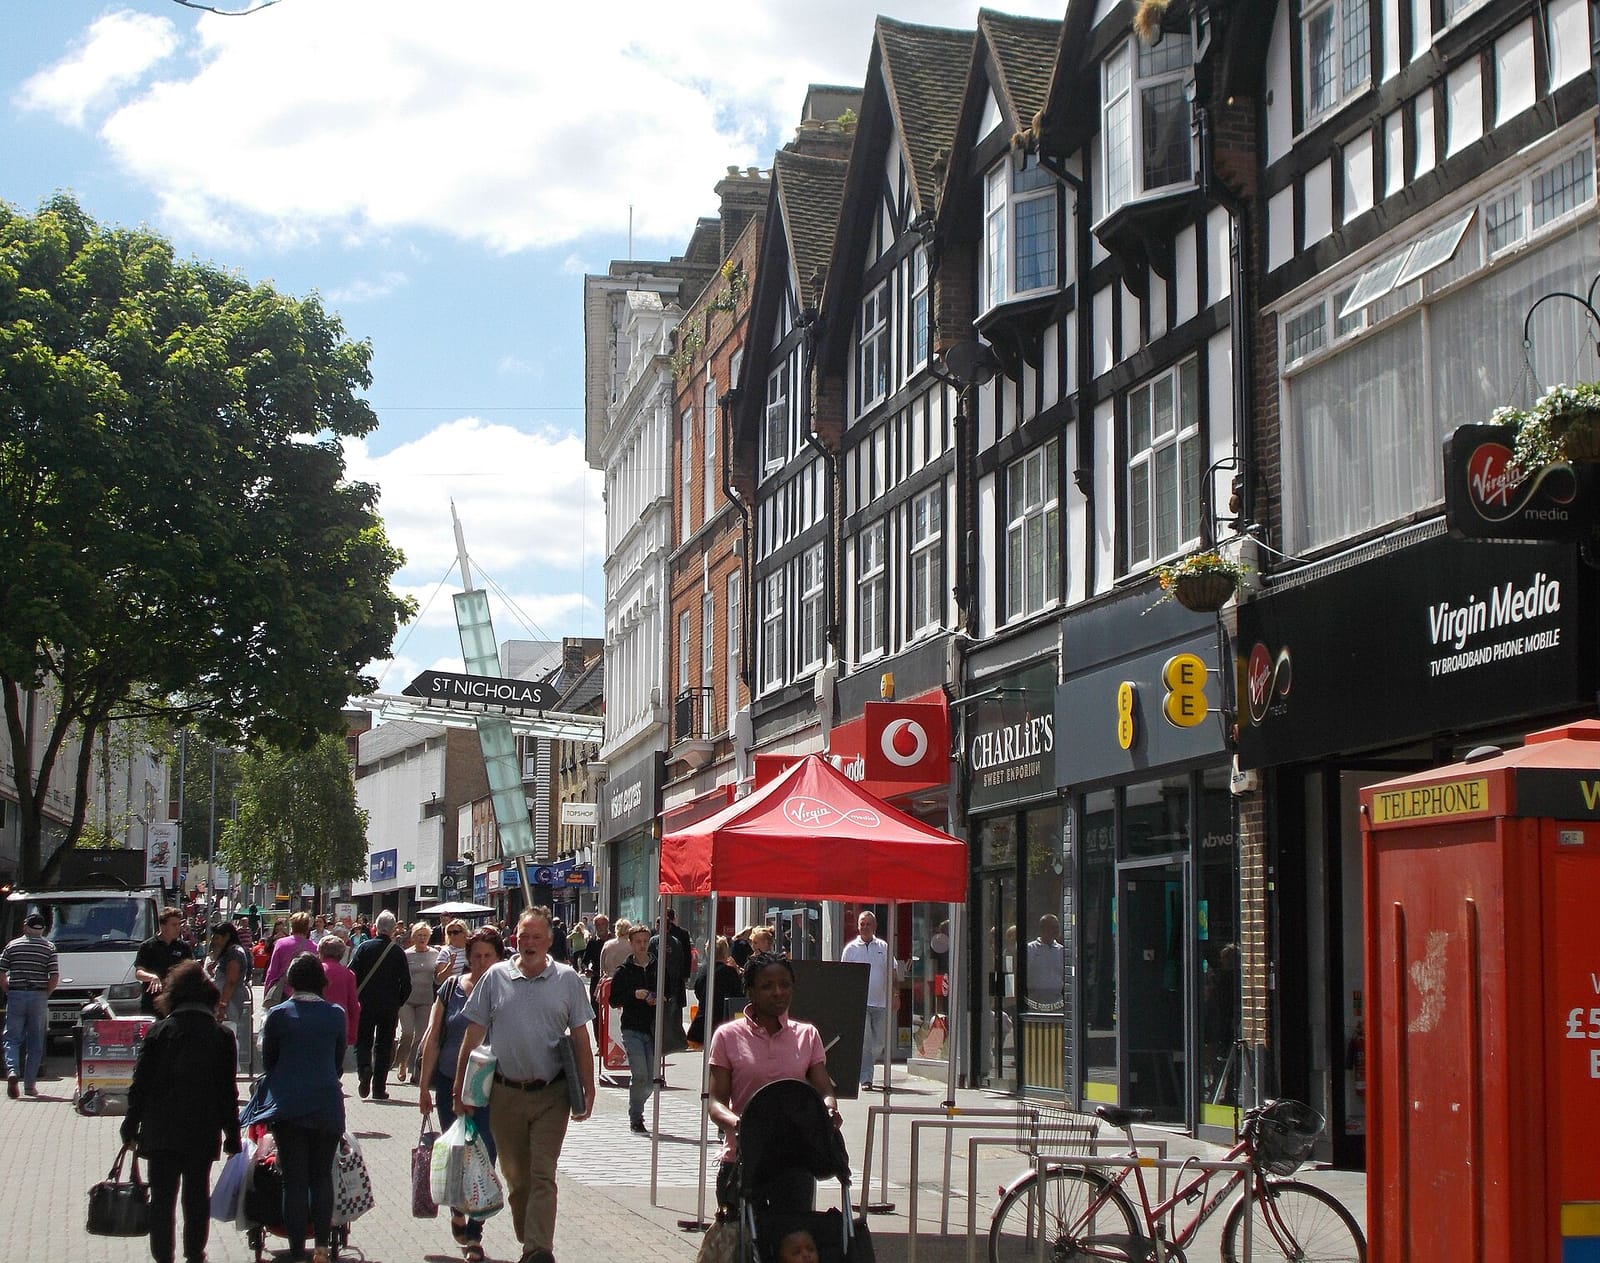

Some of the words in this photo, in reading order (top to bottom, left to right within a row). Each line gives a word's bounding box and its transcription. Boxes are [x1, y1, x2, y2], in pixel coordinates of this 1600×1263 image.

[1473, 455, 1530, 507] Virgin
[1525, 508, 1568, 521] media
[1429, 594, 1487, 650] Virgin
[1490, 572, 1561, 627] Media
[1430, 660, 1442, 677] TV
[1442, 645, 1493, 674] BROADBAND
[1493, 637, 1524, 661] PHONE
[1525, 628, 1561, 653] MOBILE
[432, 677, 451, 693] ST
[454, 681, 542, 703] NICHOLAS
[983, 769, 1005, 788] SWEET
[1006, 760, 1041, 782] EMPORIUM
[792, 802, 833, 824] Virgin
[1381, 782, 1481, 821] TELEPHONE
[88, 1046, 102, 1056] 12
[87, 1064, 95, 1074] 8
